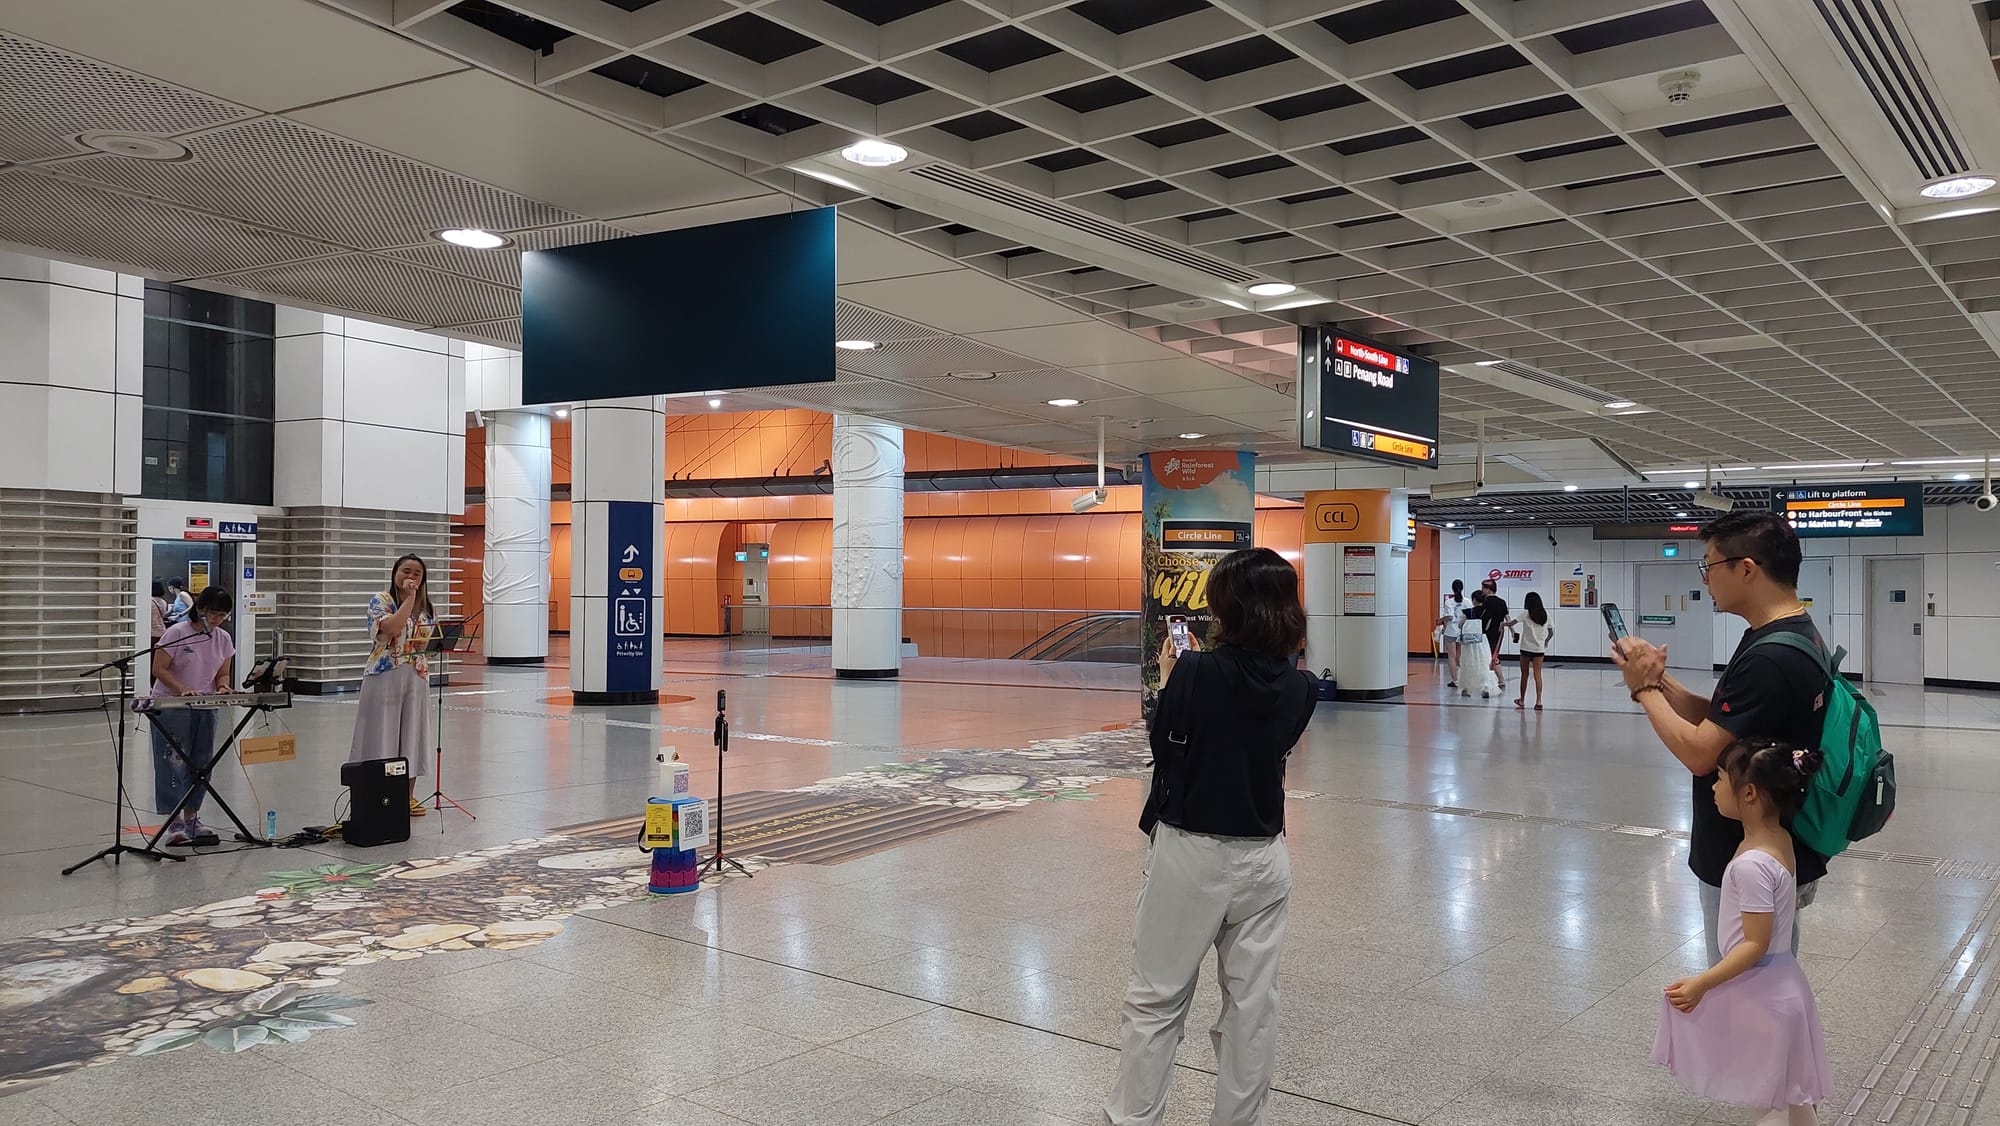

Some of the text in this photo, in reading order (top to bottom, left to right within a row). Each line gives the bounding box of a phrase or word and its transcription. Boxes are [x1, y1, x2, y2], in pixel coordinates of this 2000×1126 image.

[1350, 345, 1389, 366] North-South Line
[1353, 364, 1377, 388] Penang
[1377, 371, 1394, 389] Road
[1392, 441, 1414, 454] Circle Line
[1807, 490, 1820, 499] Lift
[1832, 489, 1867, 499] platform
[1323, 511, 1348, 523] CCL
[1808, 510, 1862, 518] HarbourFront
[1808, 520, 1837, 528] Marina
[1837, 519, 1854, 529] Bay
[1177, 531, 1222, 540] Circle Line
[1157, 556, 1220, 568] Choose yo
[1503, 570, 1534, 578] SMRT
[1198, 614, 1213, 622] Wild
